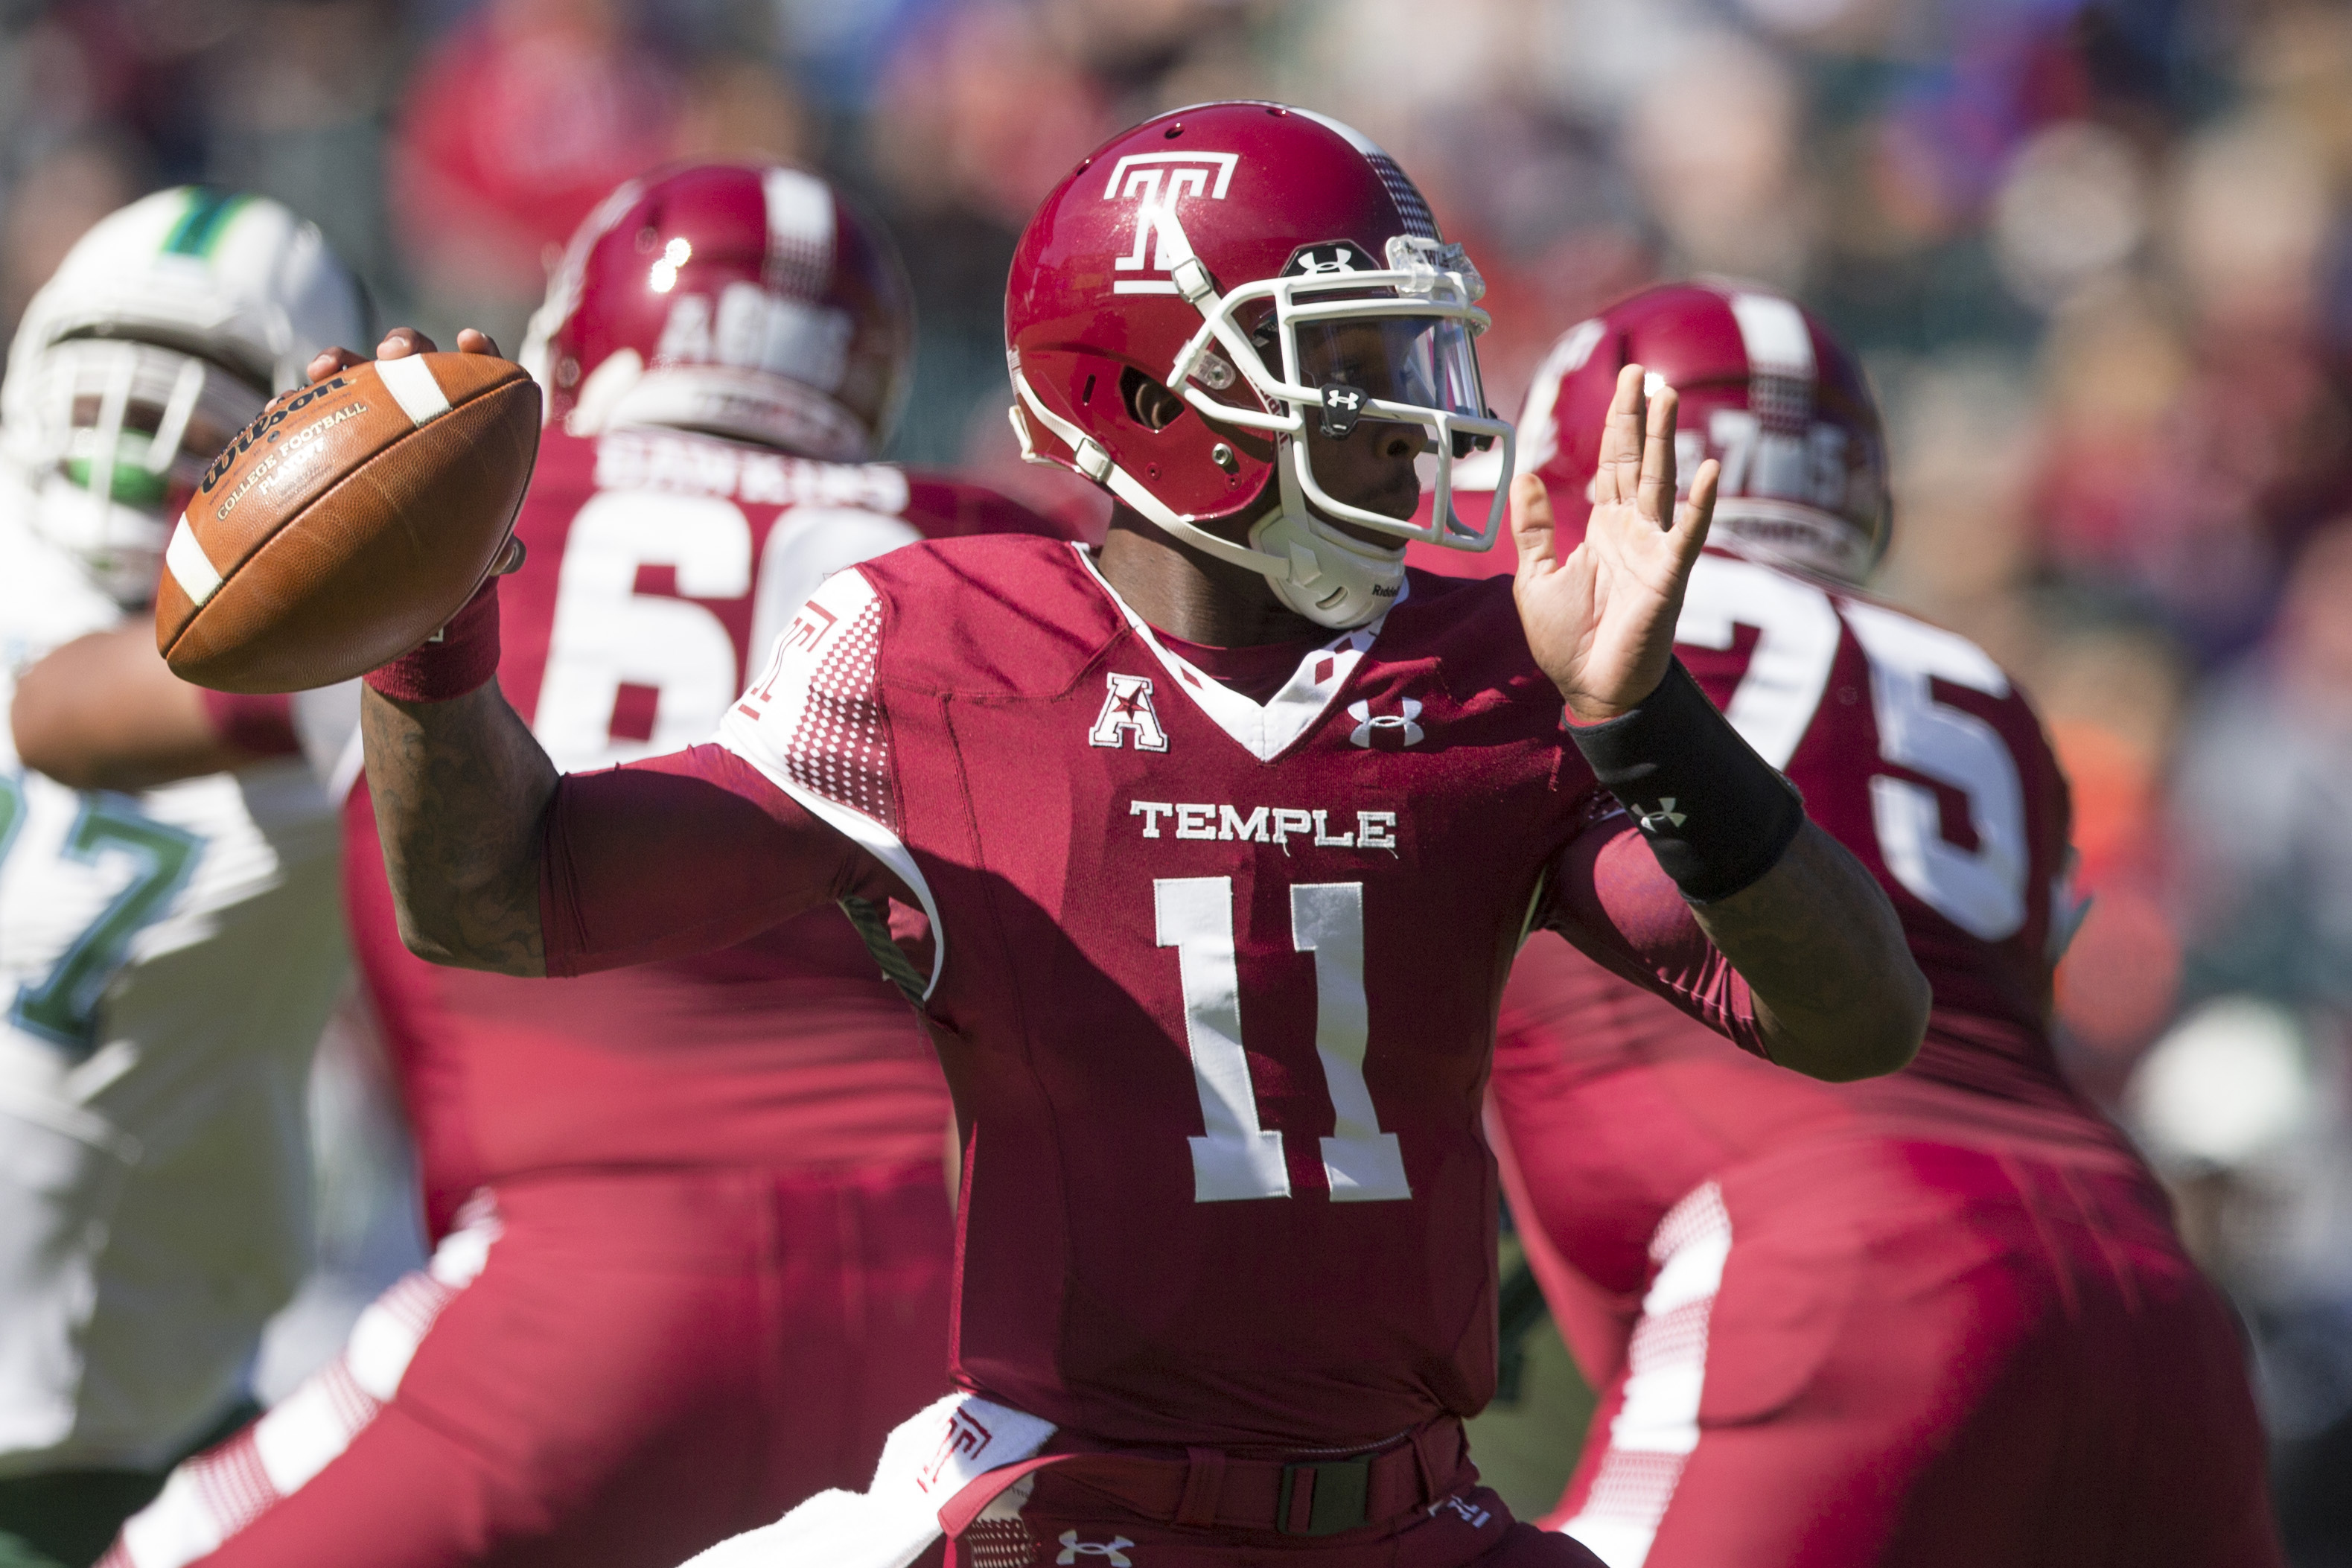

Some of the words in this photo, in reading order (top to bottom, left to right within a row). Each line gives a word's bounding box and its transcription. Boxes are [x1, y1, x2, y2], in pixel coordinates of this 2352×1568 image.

[202, 377, 348, 494] Wilson
[217, 453, 277, 520] COLLEGE
[279, 402, 367, 457] FOOTBALL
[258, 436, 325, 495] PLAYOFF
[1674, 552, 2031, 944] 75
[1129, 799, 1399, 850] TEMPLE
[1153, 876, 1413, 1203] 11
